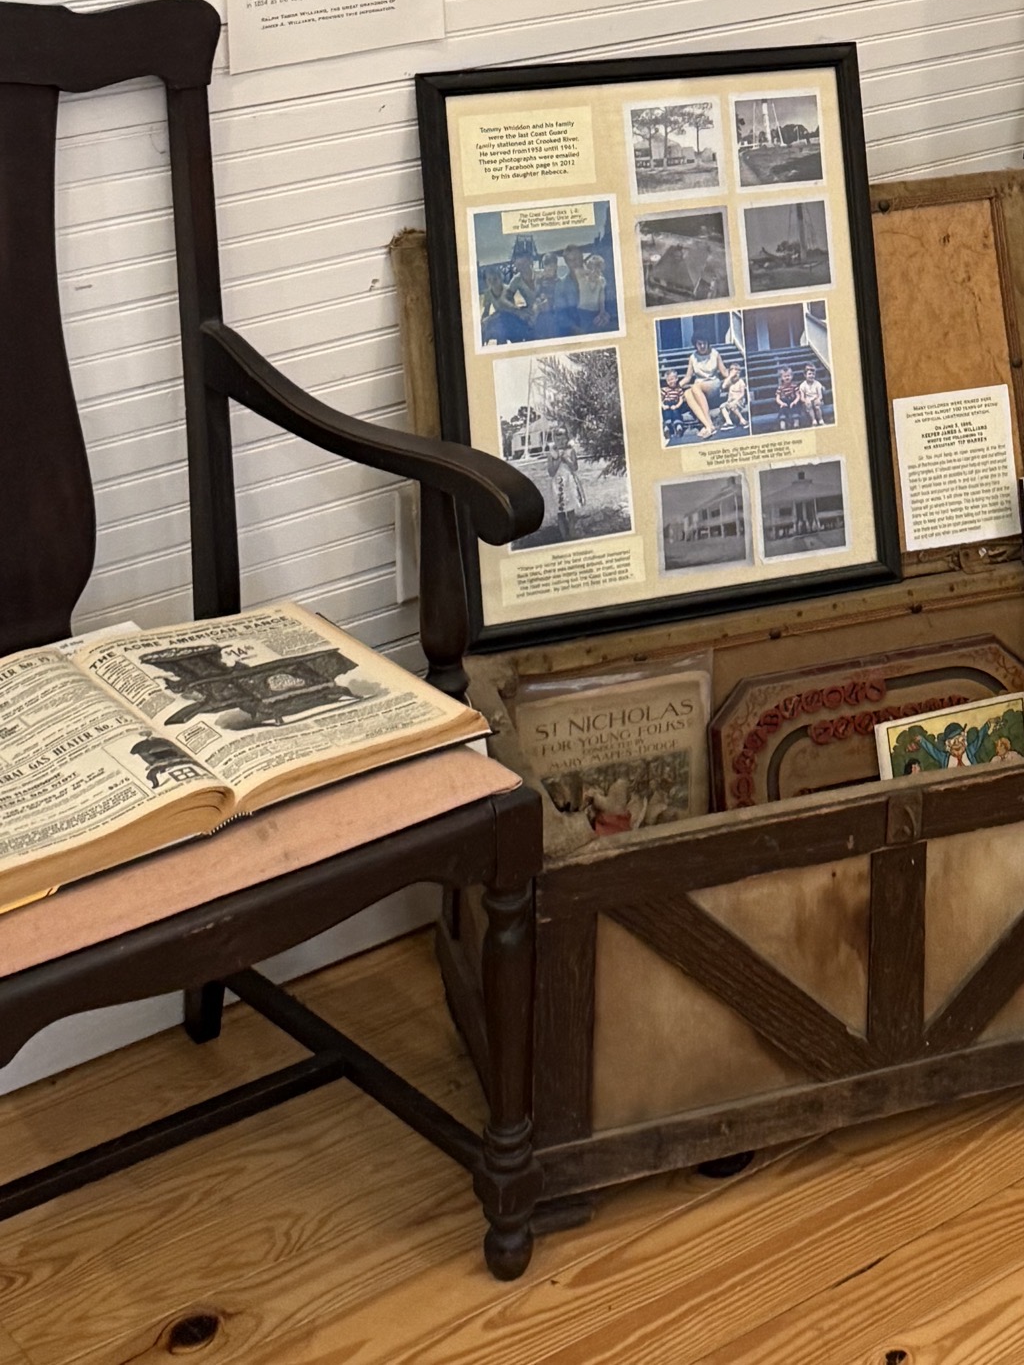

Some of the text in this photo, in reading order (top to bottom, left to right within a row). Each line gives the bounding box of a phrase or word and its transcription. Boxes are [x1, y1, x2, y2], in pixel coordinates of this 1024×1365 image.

[548, 128, 568, 136] Guard
[496, 139, 526, 148] stationed
[534, 136, 561, 145] Crooked
[489, 148, 511, 156] served
[498, 154, 537, 165] photographs
[554, 151, 580, 159] emailed
[504, 162, 534, 171] Facebook
[559, 159, 575, 167] 2012
[511, 170, 539, 179] daughter
[89, 651, 116, 669] THE
[123, 641, 162, 653] ACME
[168, 627, 237, 646] AMERICAN
[244, 615, 289, 631] RANGE
[568, 698, 694, 735] NICHOLAS
[541, 719, 686, 756] FOR YOUNG FOLKS
[28, 756, 51, 770] GAS
[52, 732, 93, 756] HEATER
[551, 758, 582, 770] MARY
